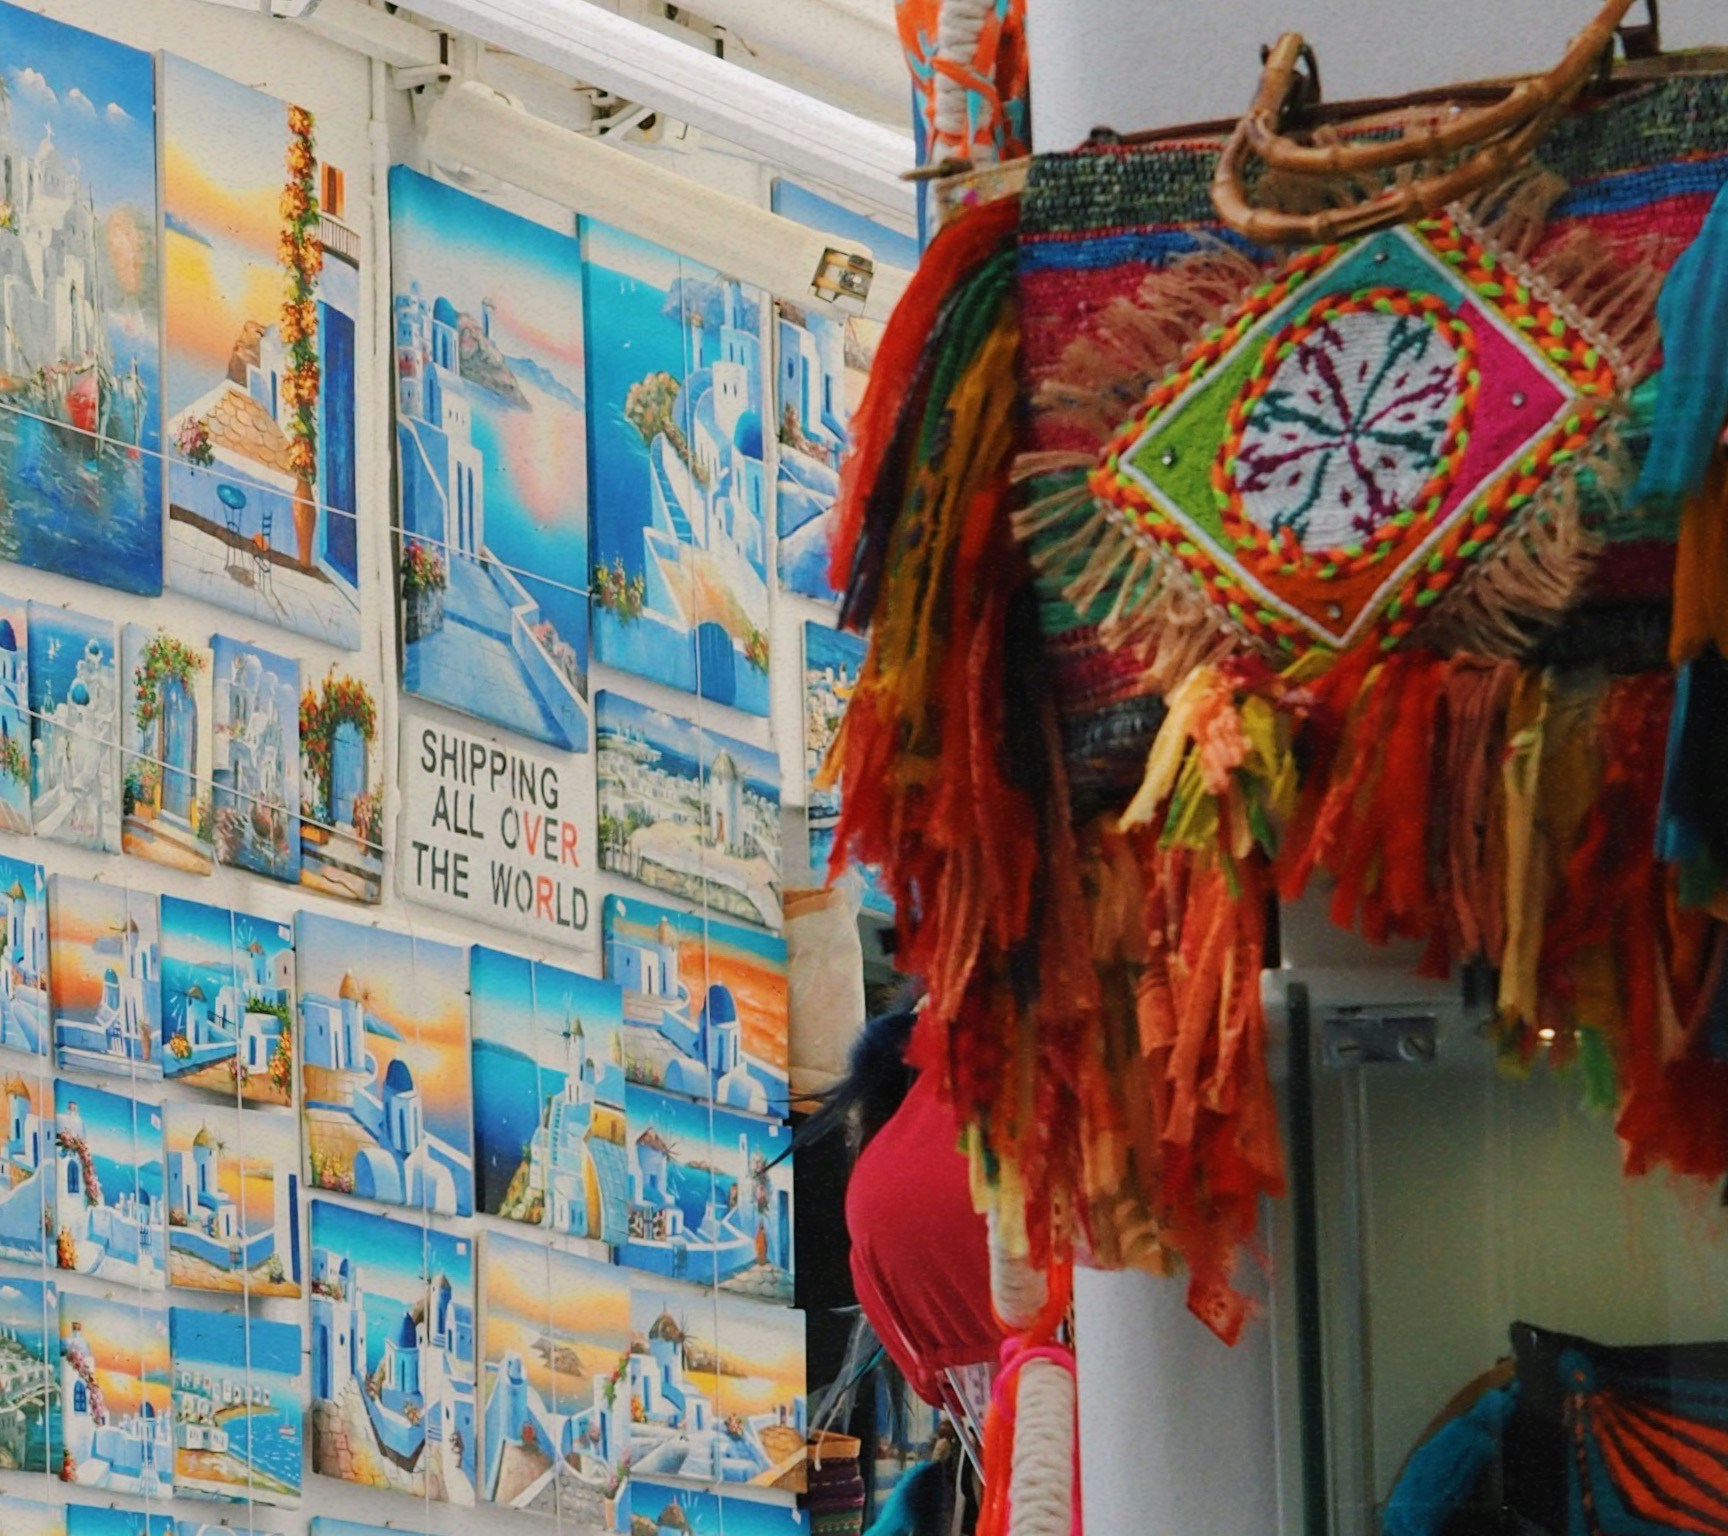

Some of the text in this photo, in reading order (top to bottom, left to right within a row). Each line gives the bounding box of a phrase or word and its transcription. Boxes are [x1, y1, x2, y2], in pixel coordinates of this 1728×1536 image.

[421, 728, 559, 810] SHIPPING
[432, 785, 580, 867] ALL OVER
[412, 840, 588, 931] THE WORLD
